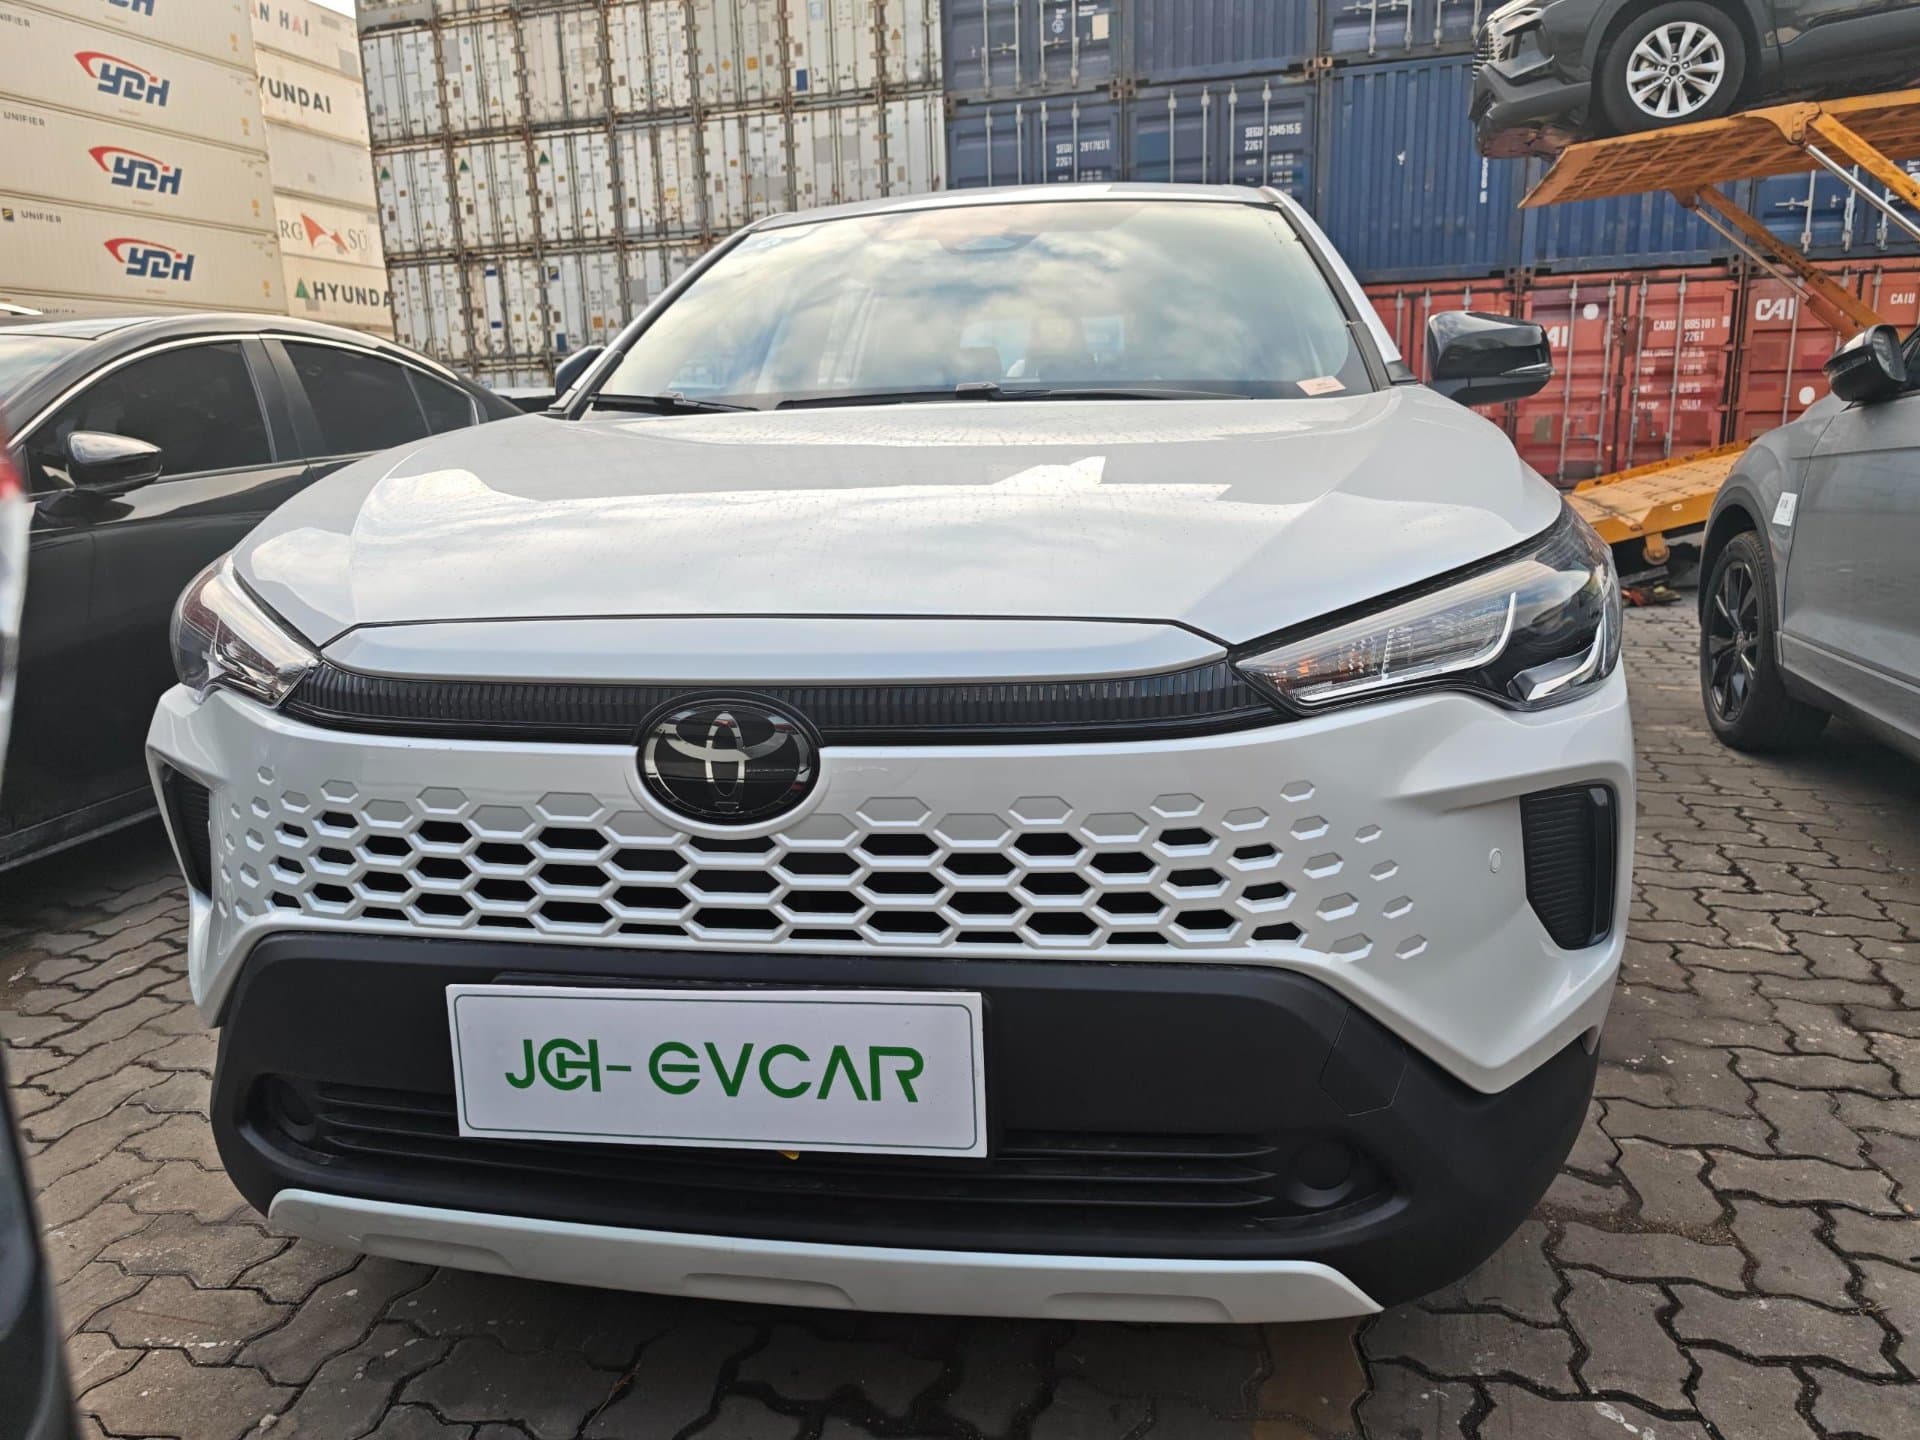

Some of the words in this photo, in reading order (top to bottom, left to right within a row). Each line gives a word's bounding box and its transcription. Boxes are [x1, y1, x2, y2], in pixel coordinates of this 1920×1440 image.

[279, 10, 309, 36] HAI
[3, 111, 46, 127] UNIFIER
[20, 210, 62, 224] UNIFIER
[1890, 292, 1916, 305] CAIU
[1755, 297, 1795, 321] CAI
